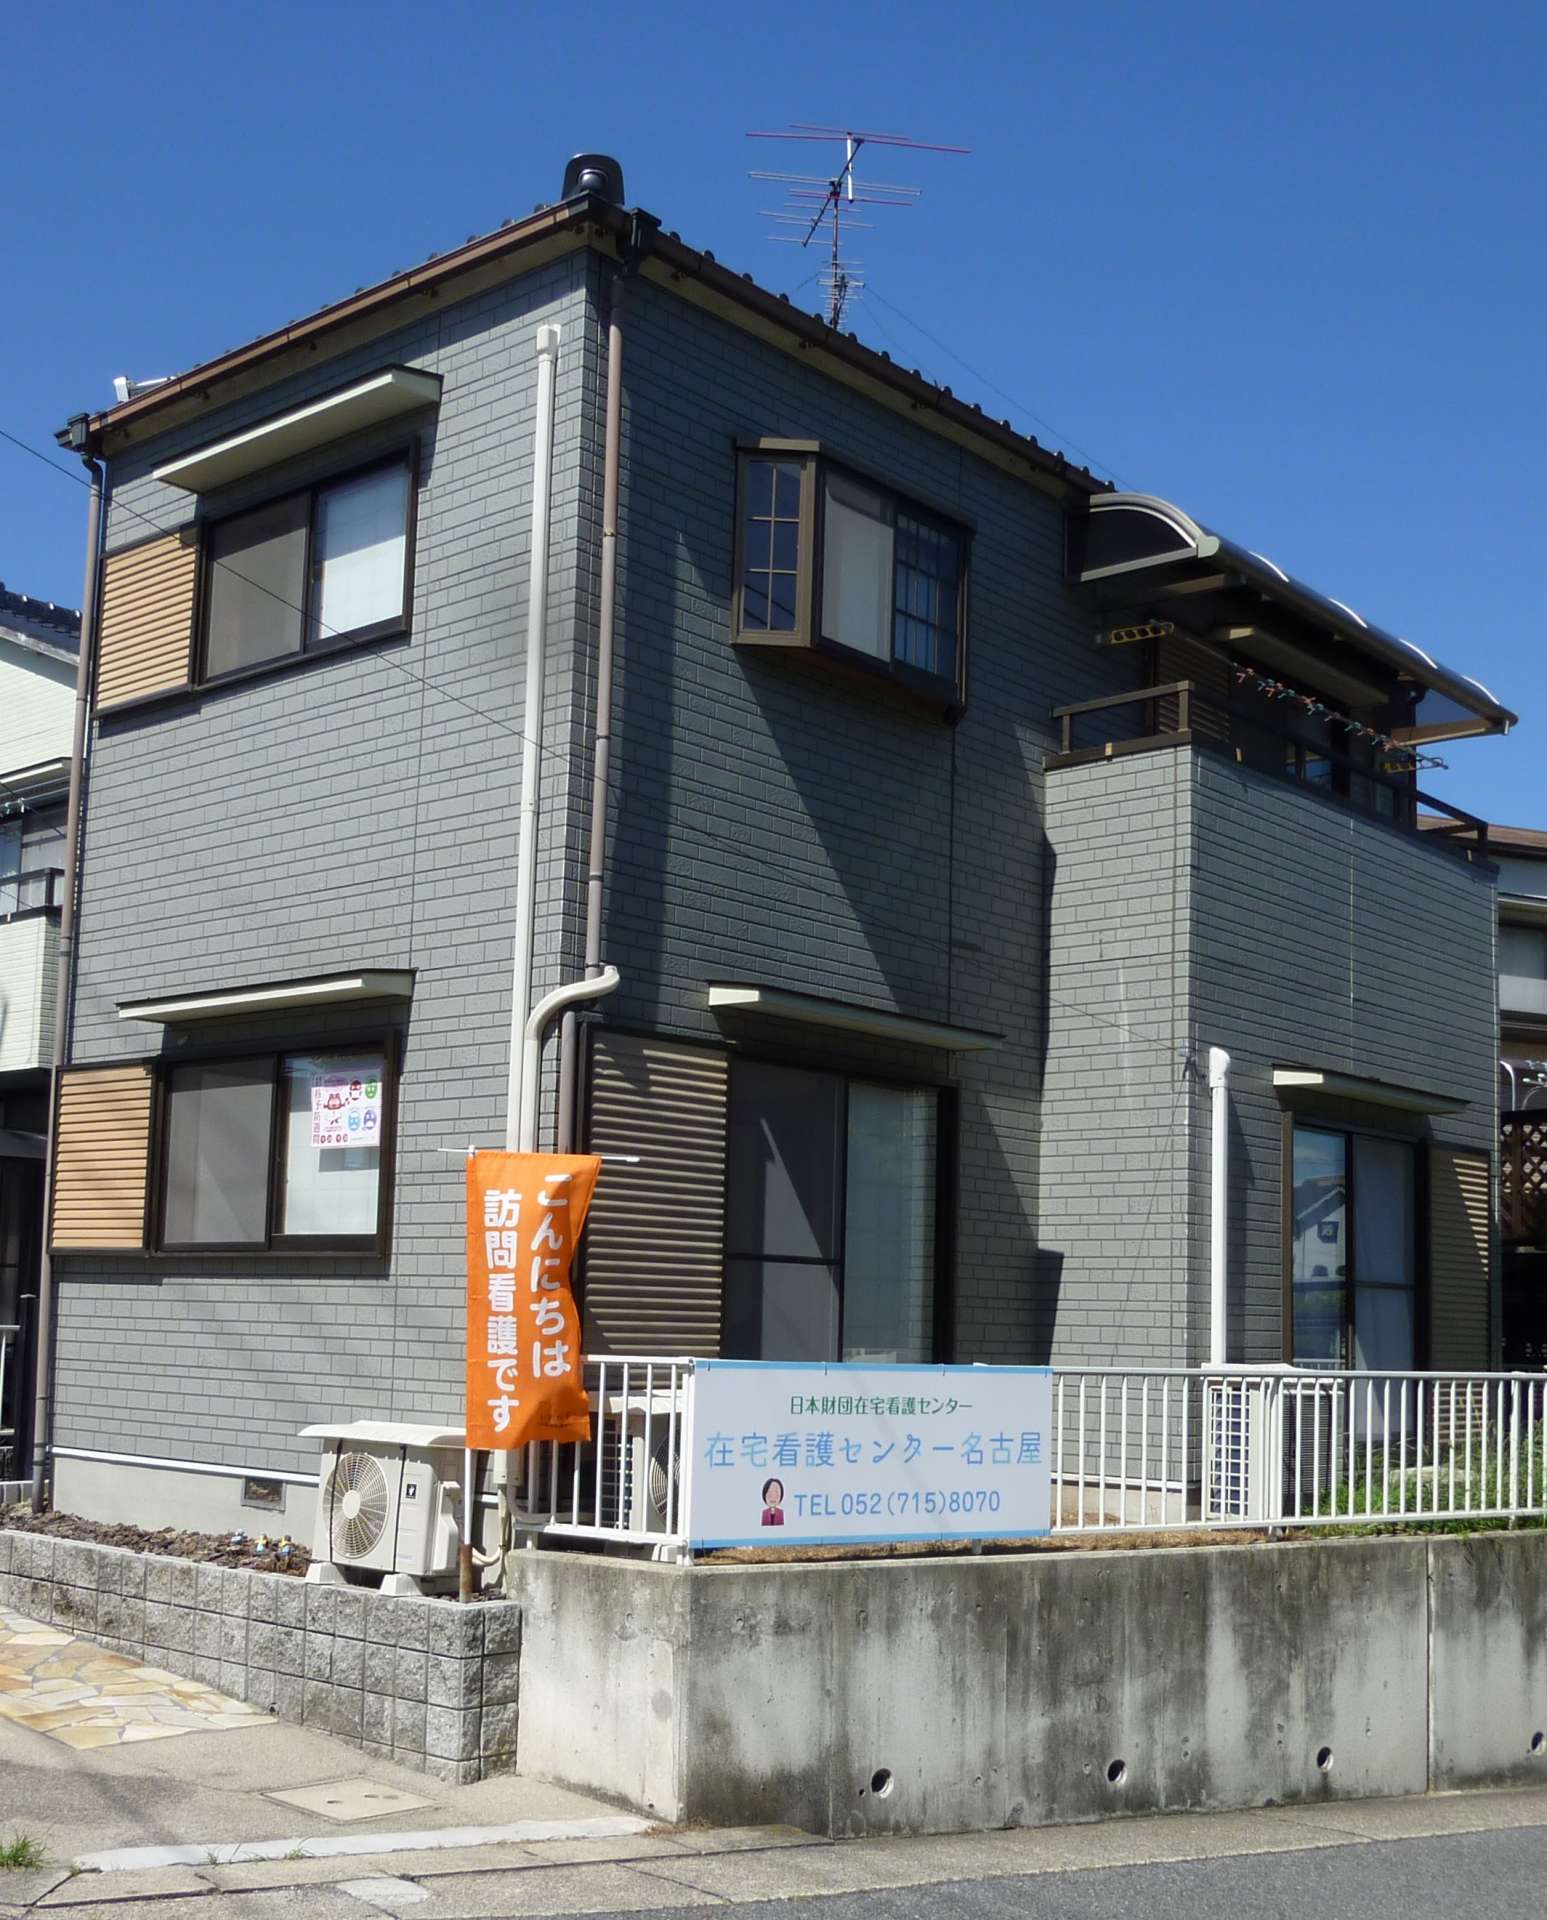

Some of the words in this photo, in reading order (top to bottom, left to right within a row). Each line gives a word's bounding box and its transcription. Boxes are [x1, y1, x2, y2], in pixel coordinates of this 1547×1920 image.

[483, 1188, 522, 1432] 訪問看護です
[529, 1173, 572, 1378] こんにちは
[704, 1431, 1043, 1468] 在宅看護センター名古屋
[790, 1395, 973, 1416] 日本財団在宅看護センター
